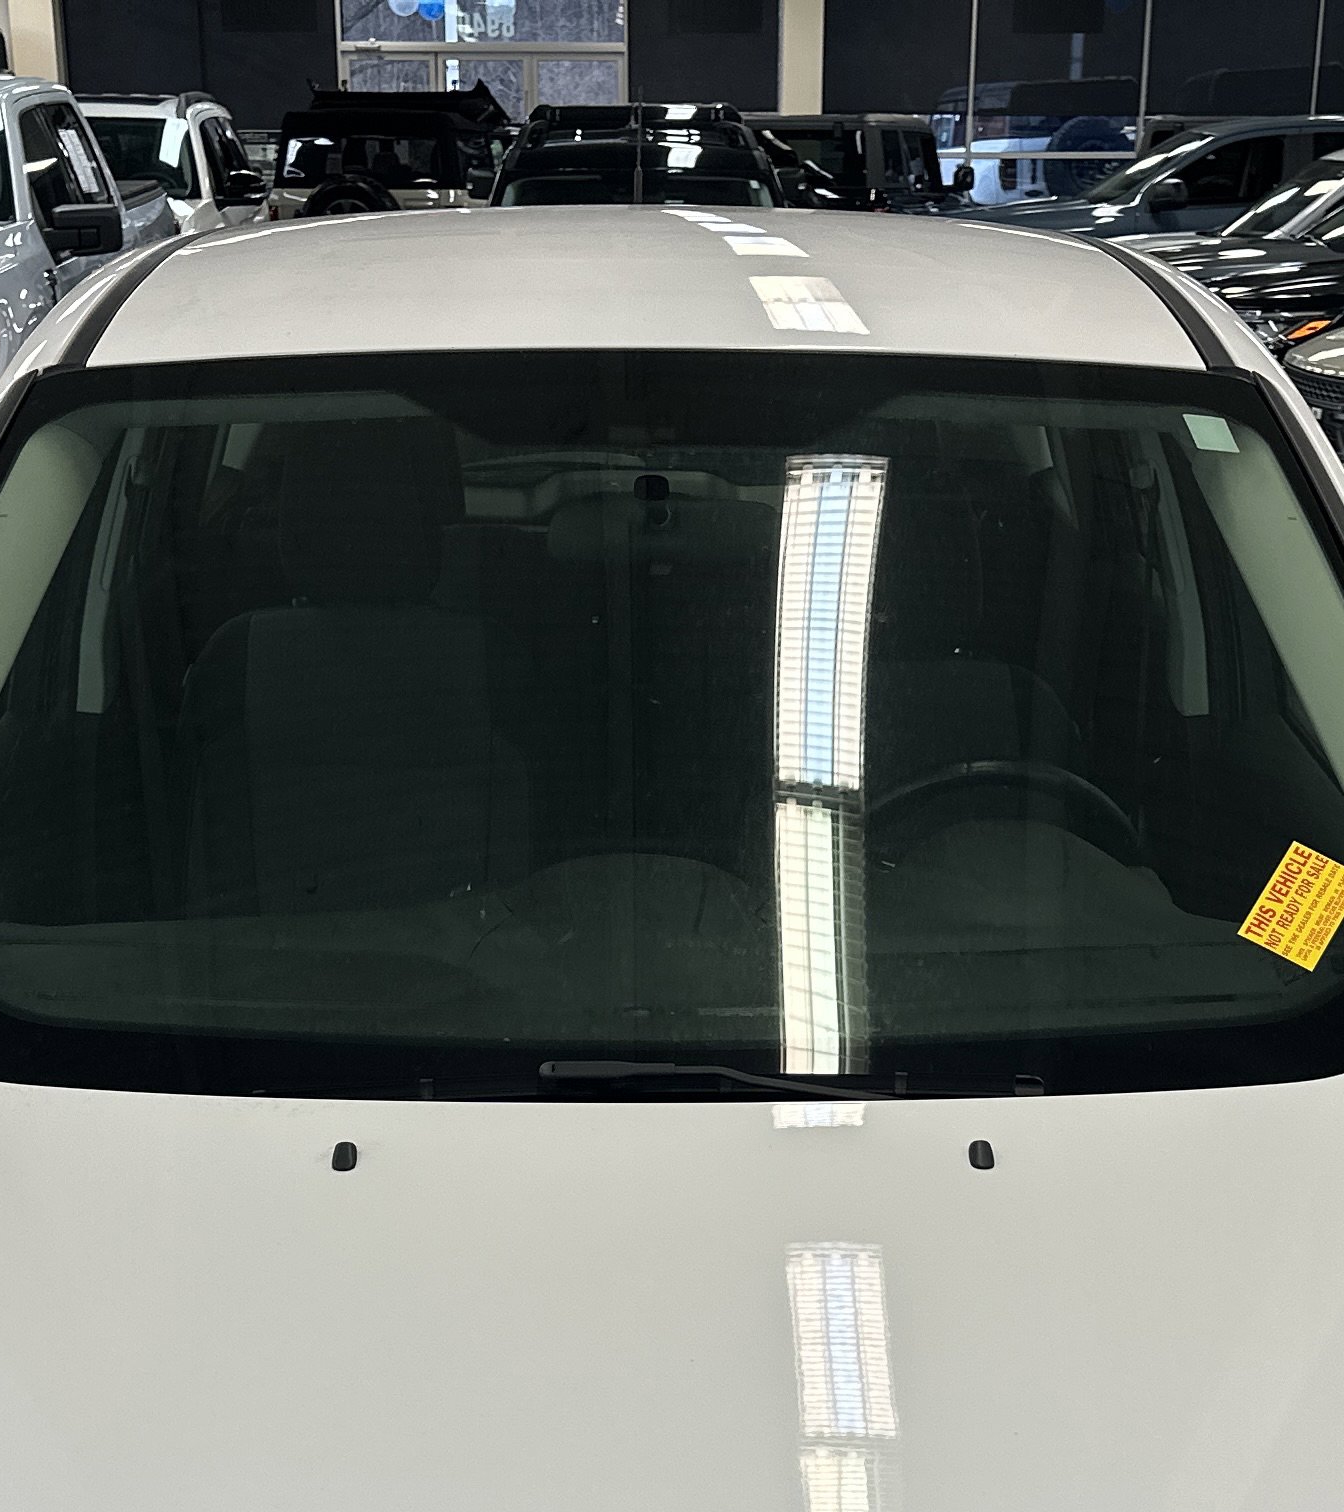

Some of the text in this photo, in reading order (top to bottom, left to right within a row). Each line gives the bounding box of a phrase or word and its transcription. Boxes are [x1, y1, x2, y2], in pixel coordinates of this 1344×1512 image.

[1245, 846, 1312, 937] THIS VEHICLE
[1264, 928, 1284, 949] NOT
[1276, 896, 1302, 930] READY
[1294, 878, 1315, 899] FOR
[1306, 855, 1329, 879] SALE
